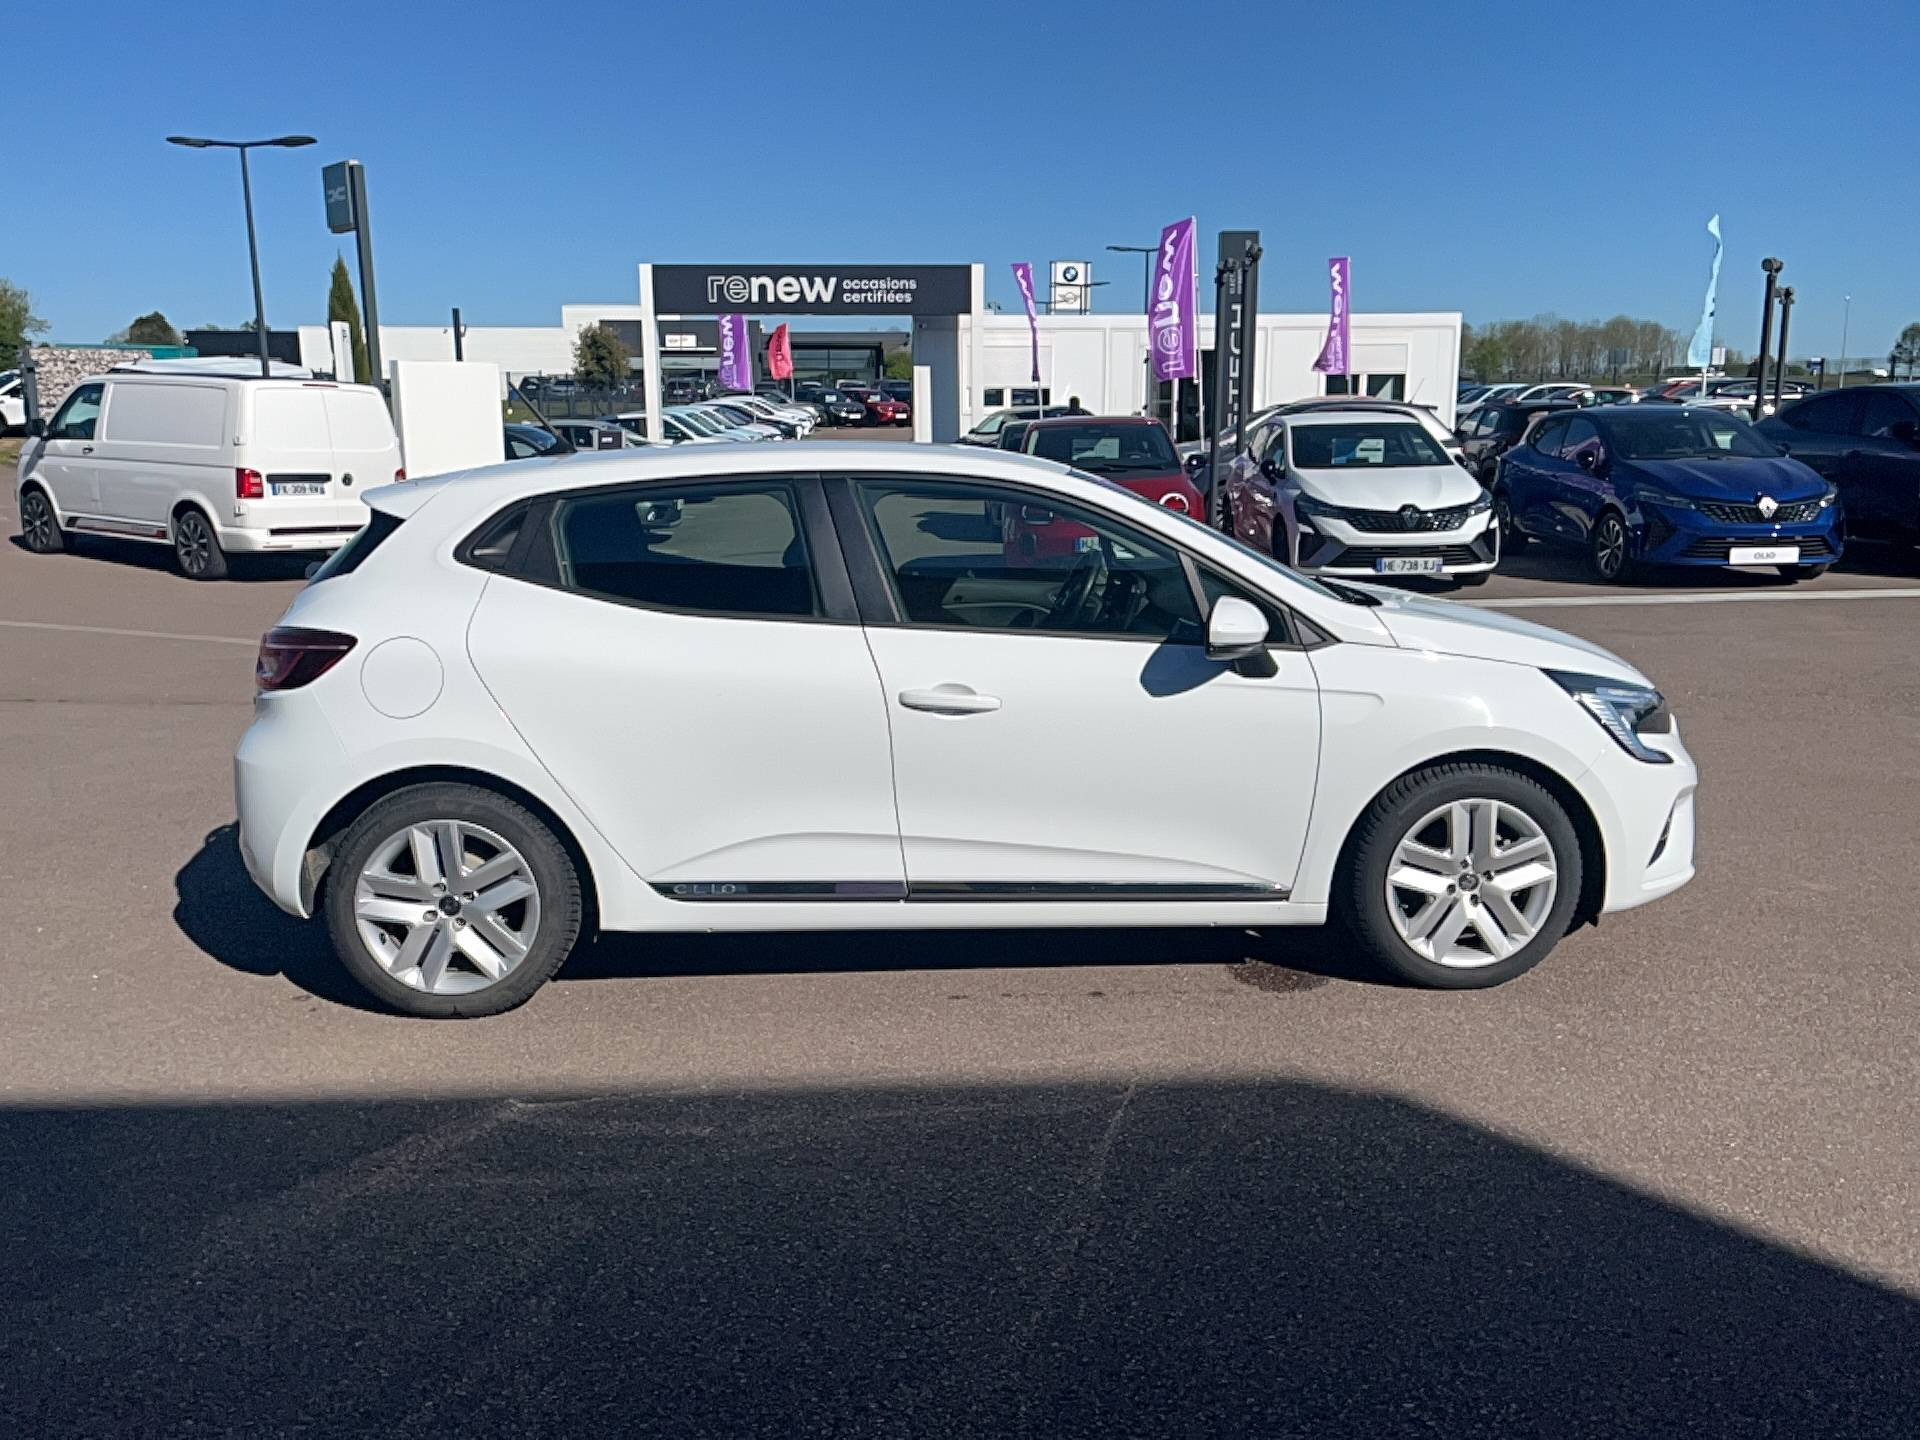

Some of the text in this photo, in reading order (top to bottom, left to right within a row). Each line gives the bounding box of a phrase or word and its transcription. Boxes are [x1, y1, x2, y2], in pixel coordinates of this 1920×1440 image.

[707, 275, 837, 303] renew
[842, 277, 917, 290] occasions
[842, 289, 913, 303] certifiées
[673, 883, 737, 895] CLIO
